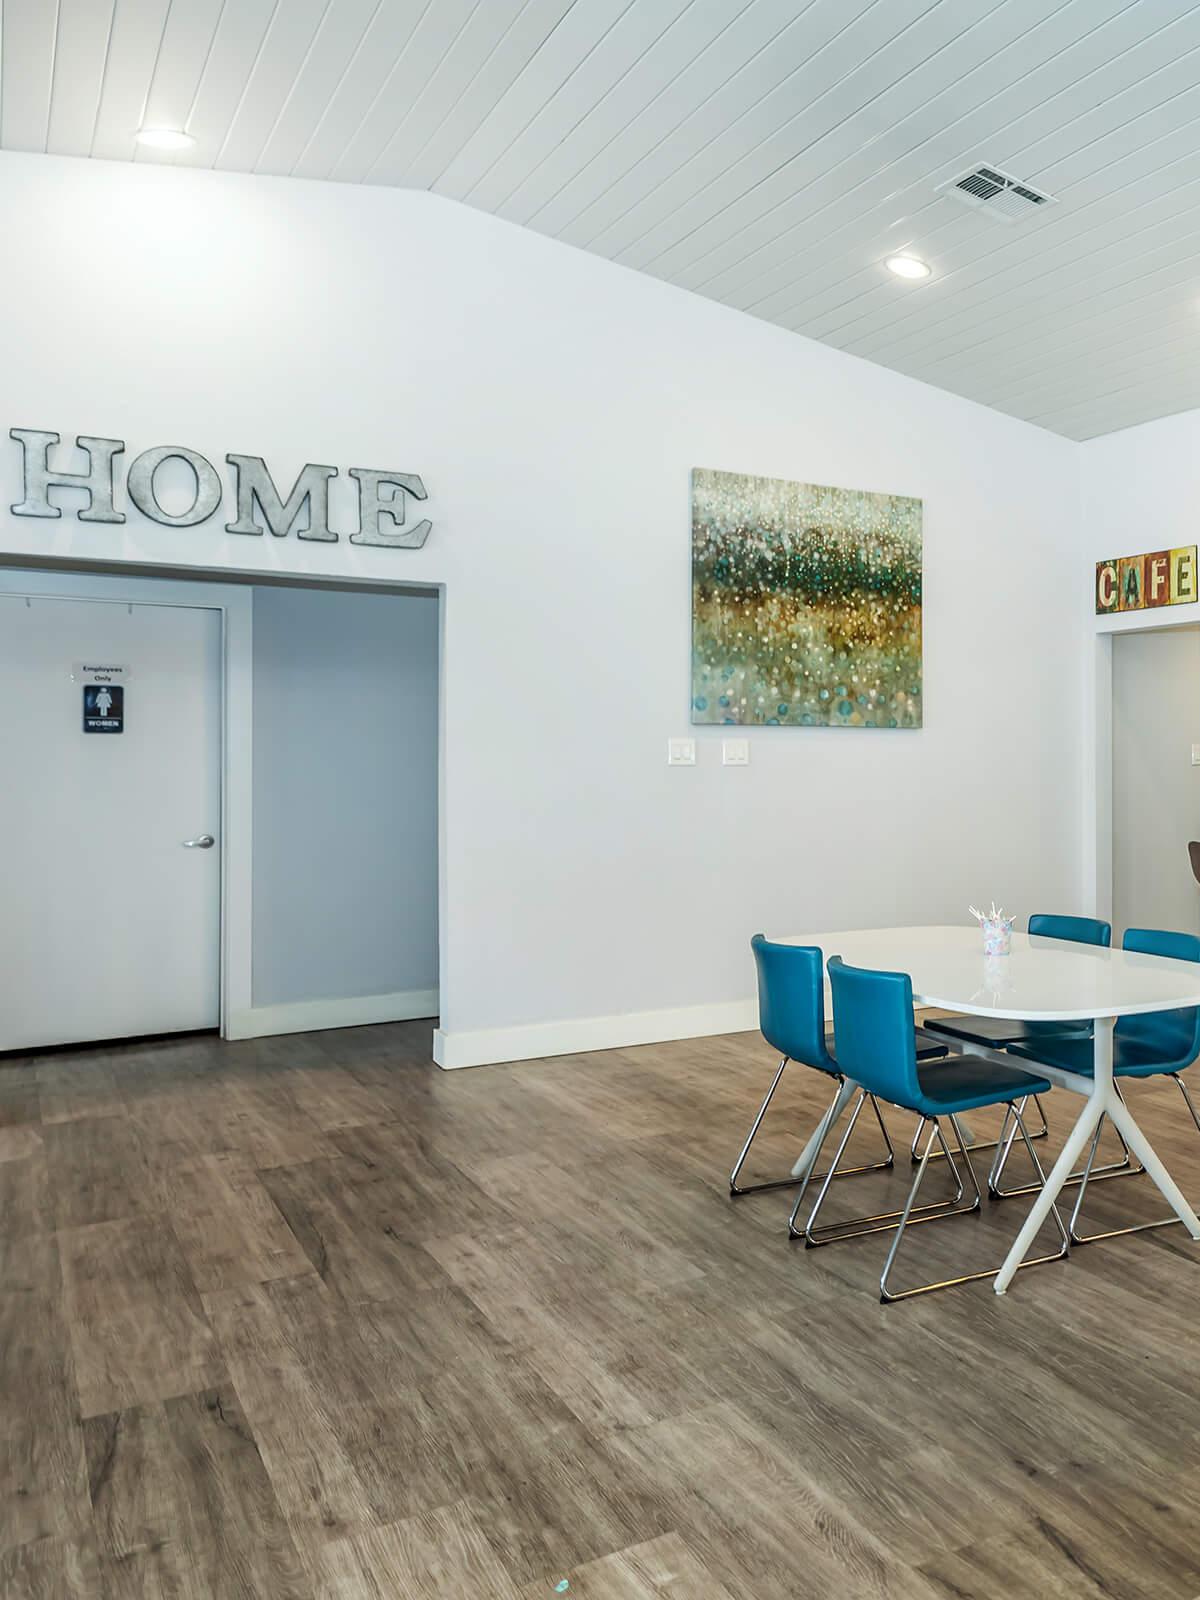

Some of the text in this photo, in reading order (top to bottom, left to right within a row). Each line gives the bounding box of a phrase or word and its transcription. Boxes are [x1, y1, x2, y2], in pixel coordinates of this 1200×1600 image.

[9, 427, 434, 550] HOME
[1098, 555, 1191, 607] CAFE
[83, 665, 123, 673] Employees
